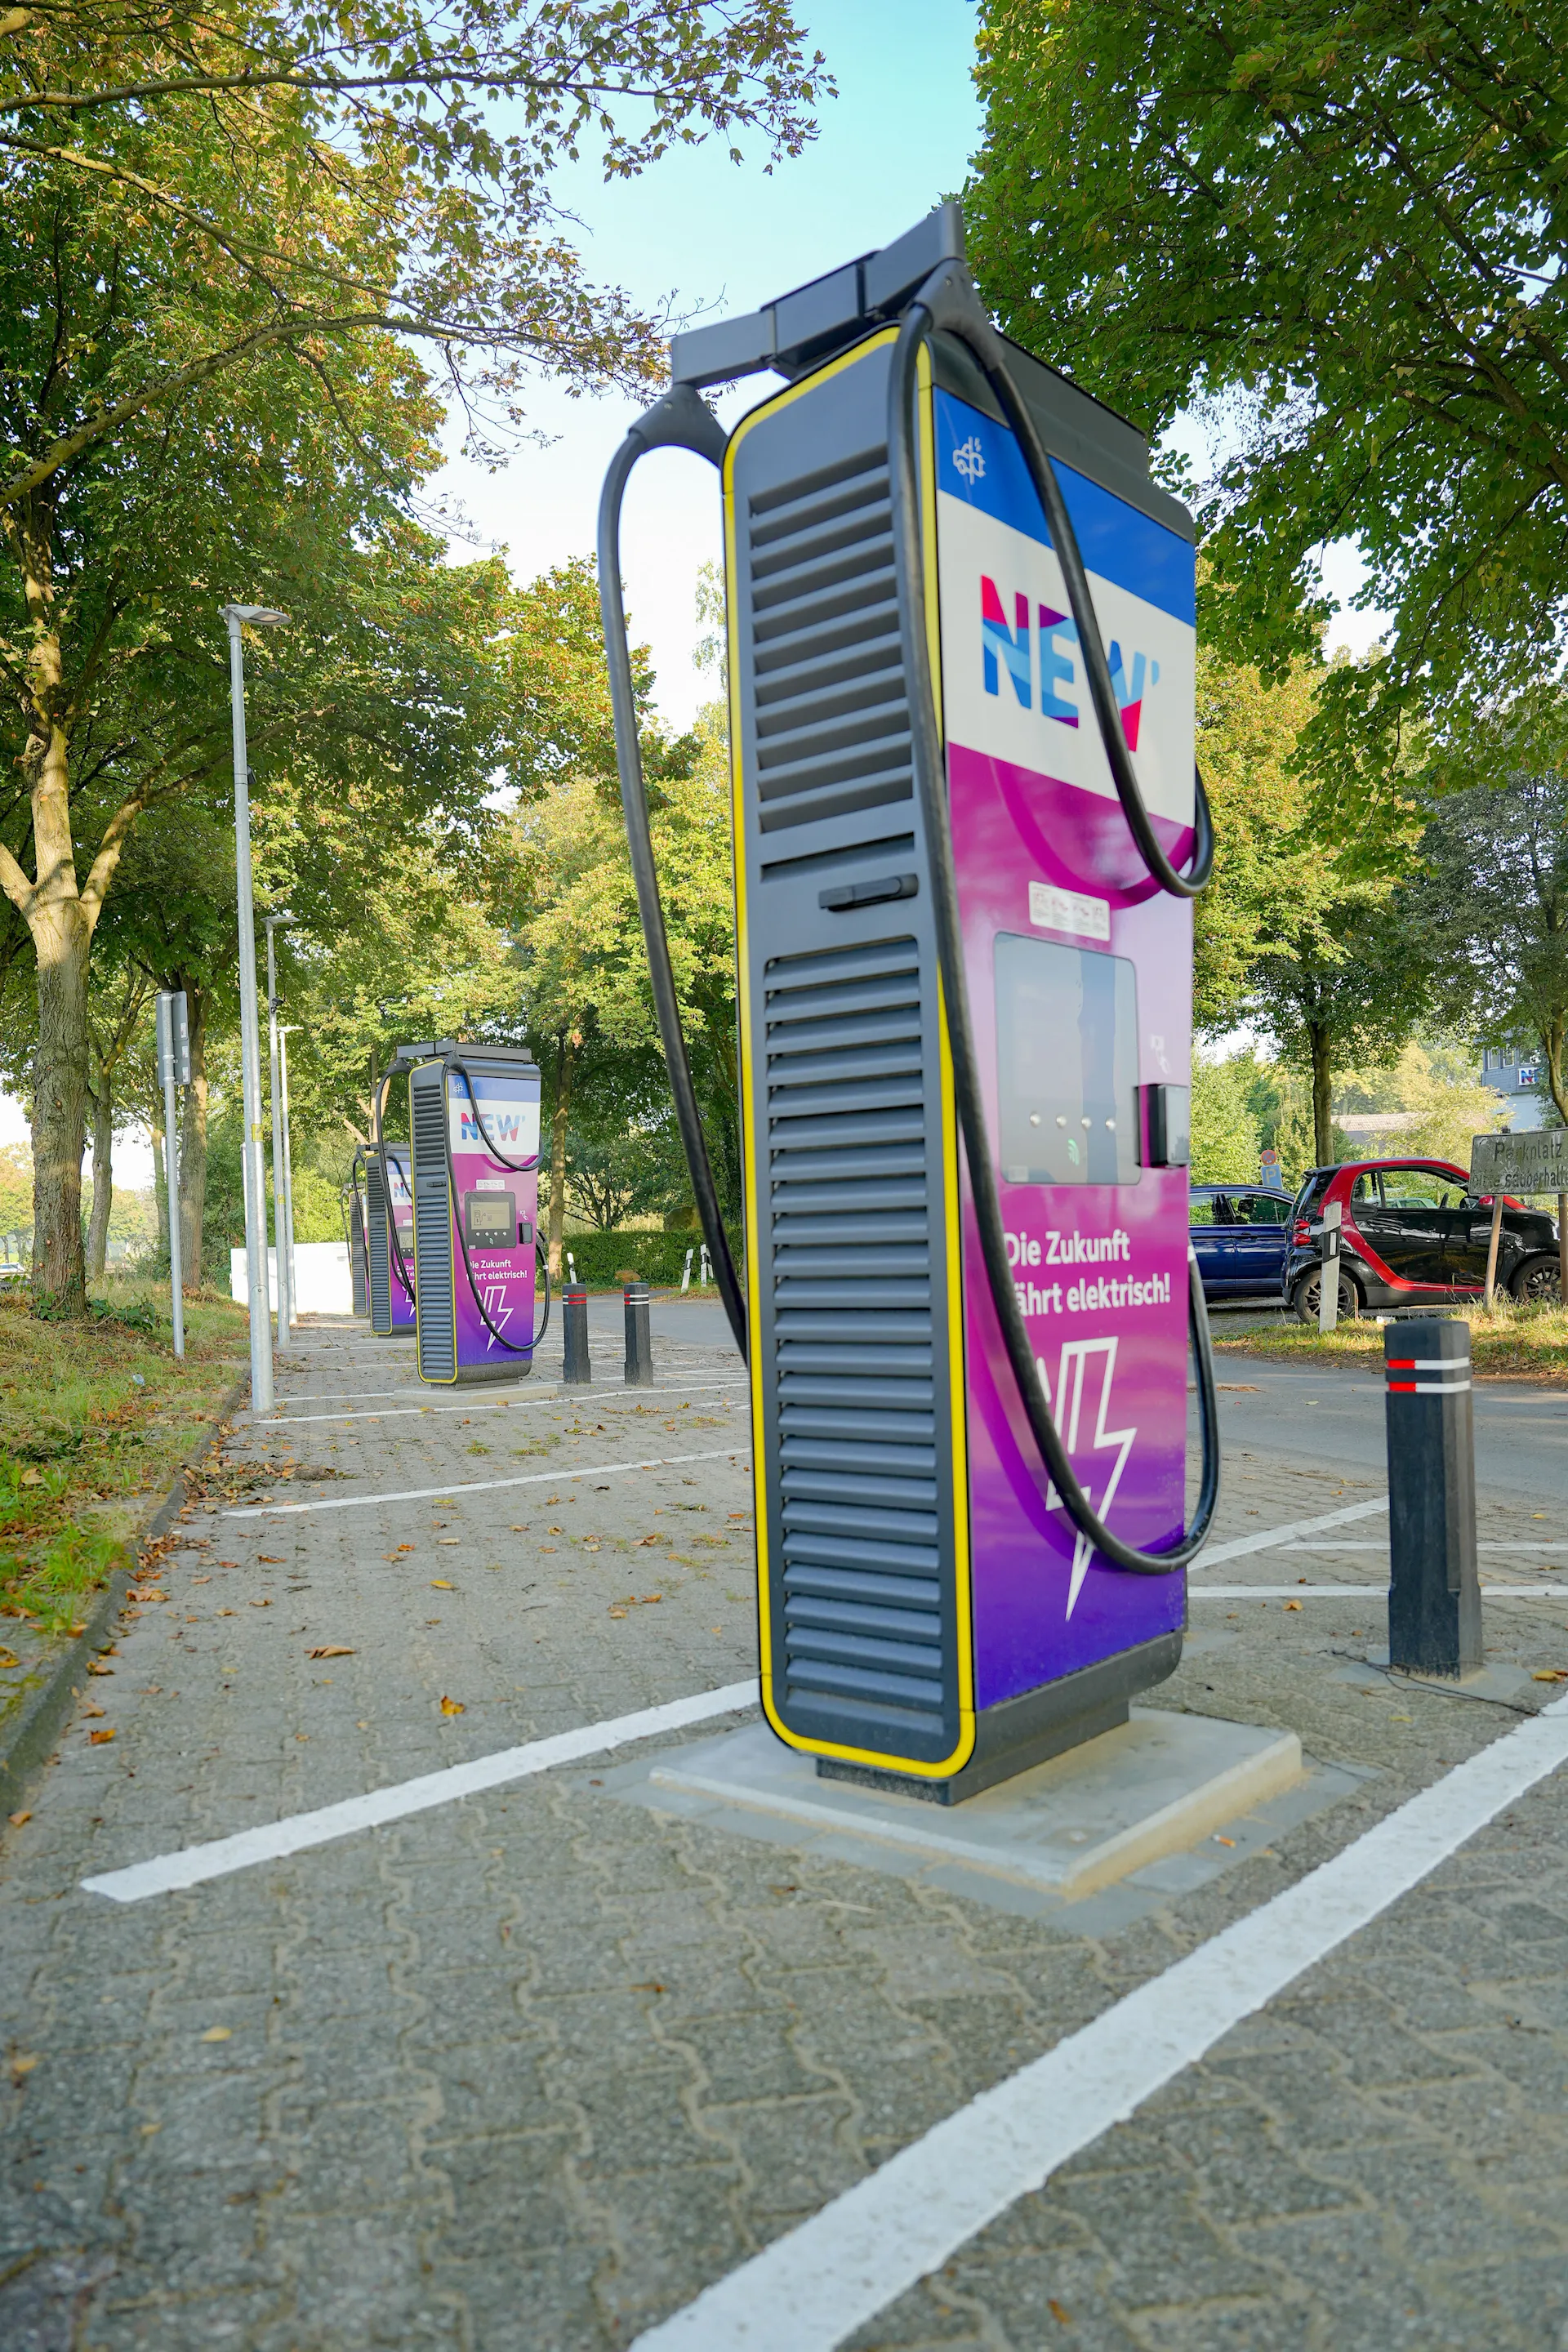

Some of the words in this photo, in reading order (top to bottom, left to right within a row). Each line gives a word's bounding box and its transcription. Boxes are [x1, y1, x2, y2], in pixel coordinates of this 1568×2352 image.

[1494, 1138, 1562, 1165] Parkplatz
[1266, 1169, 1276, 1184] P
[1003, 1231, 1042, 1267] Die
[1045, 1228, 1131, 1265] Zukunft
[480, 1258, 512, 1269] Zukunft
[488, 1269, 528, 1280] elektrisch!
[1067, 1272, 1171, 1312] elektrisch!
